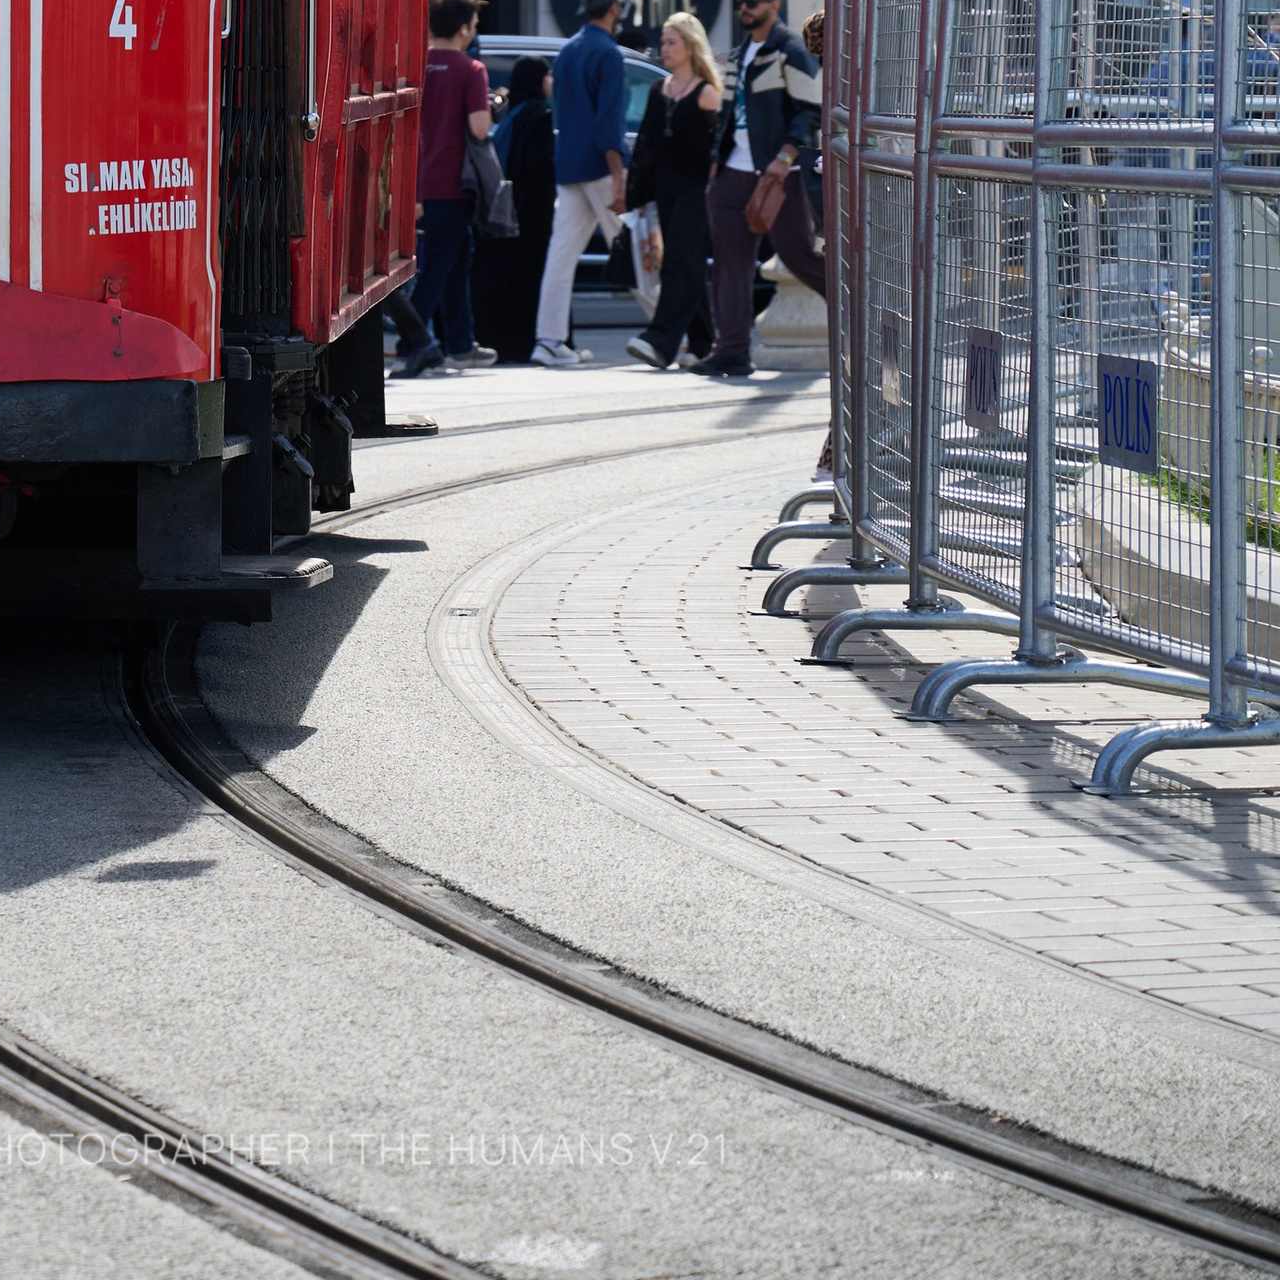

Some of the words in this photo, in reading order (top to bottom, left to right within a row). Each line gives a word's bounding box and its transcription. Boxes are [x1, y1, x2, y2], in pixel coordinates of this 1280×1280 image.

[64, 159, 147, 193] SIMAK
[89, 194, 198, 236] EHLİKELİDİR
[1102, 360, 1151, 456] POLİS
